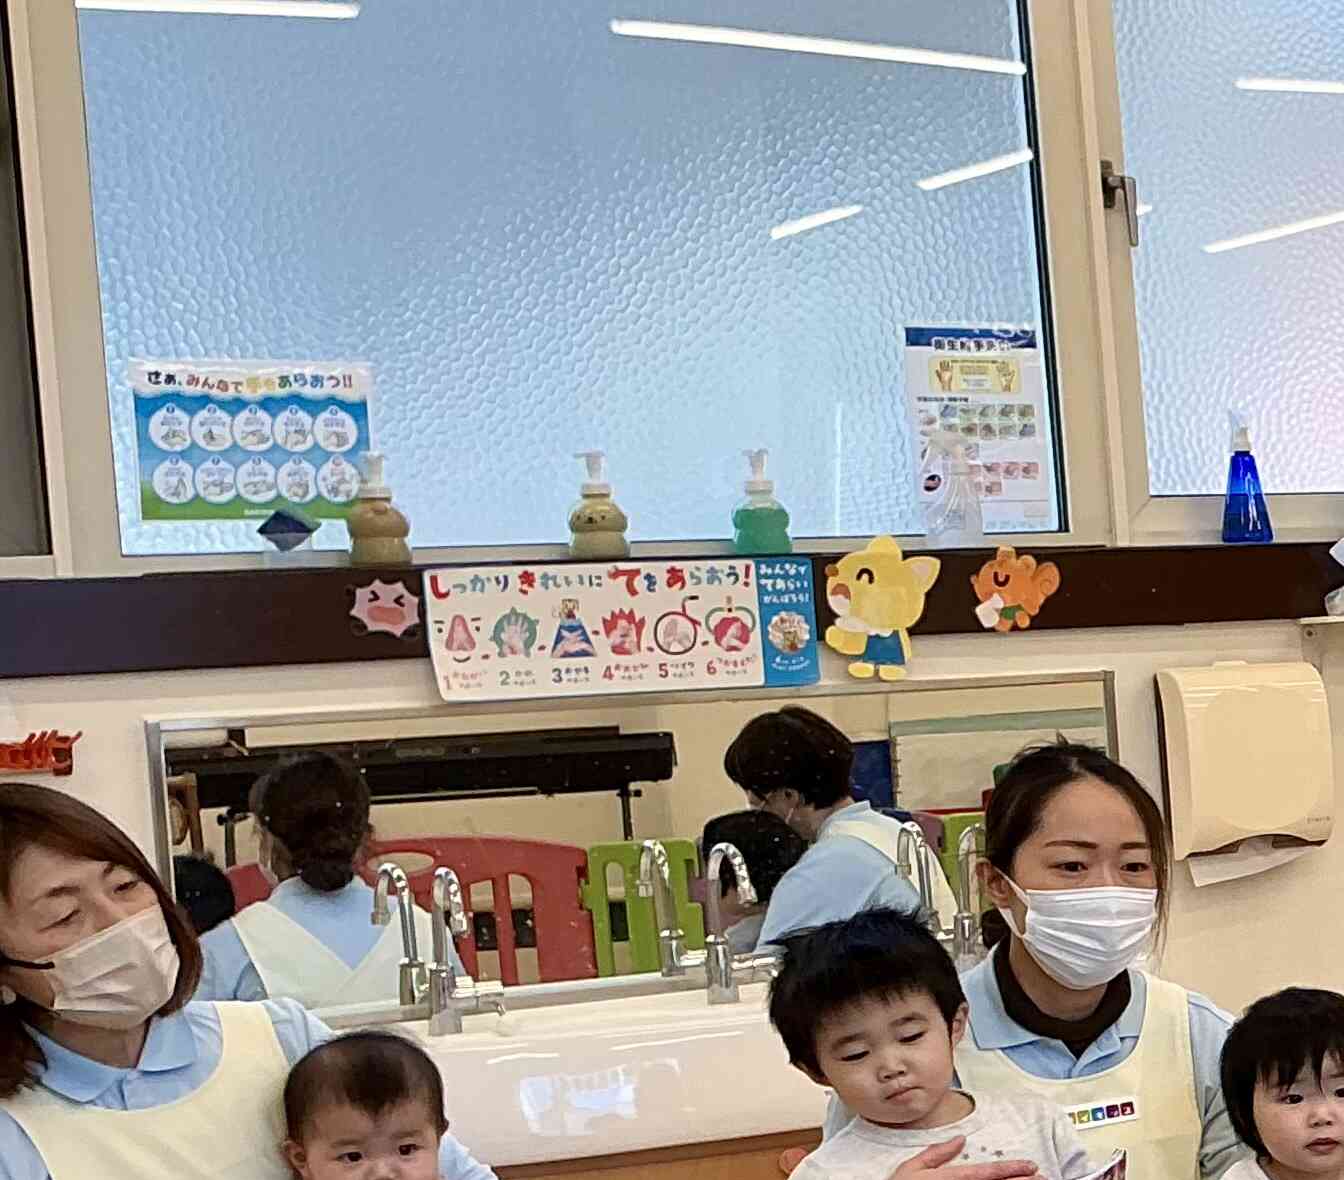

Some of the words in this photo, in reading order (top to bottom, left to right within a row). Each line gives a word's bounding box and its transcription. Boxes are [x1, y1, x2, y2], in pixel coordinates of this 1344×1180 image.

[551, 667, 563, 684] 3
[602, 665, 615, 681] 4
[658, 663, 669, 679] 5
[706, 660, 718, 675] 6
[499, 670, 511, 687] 2
